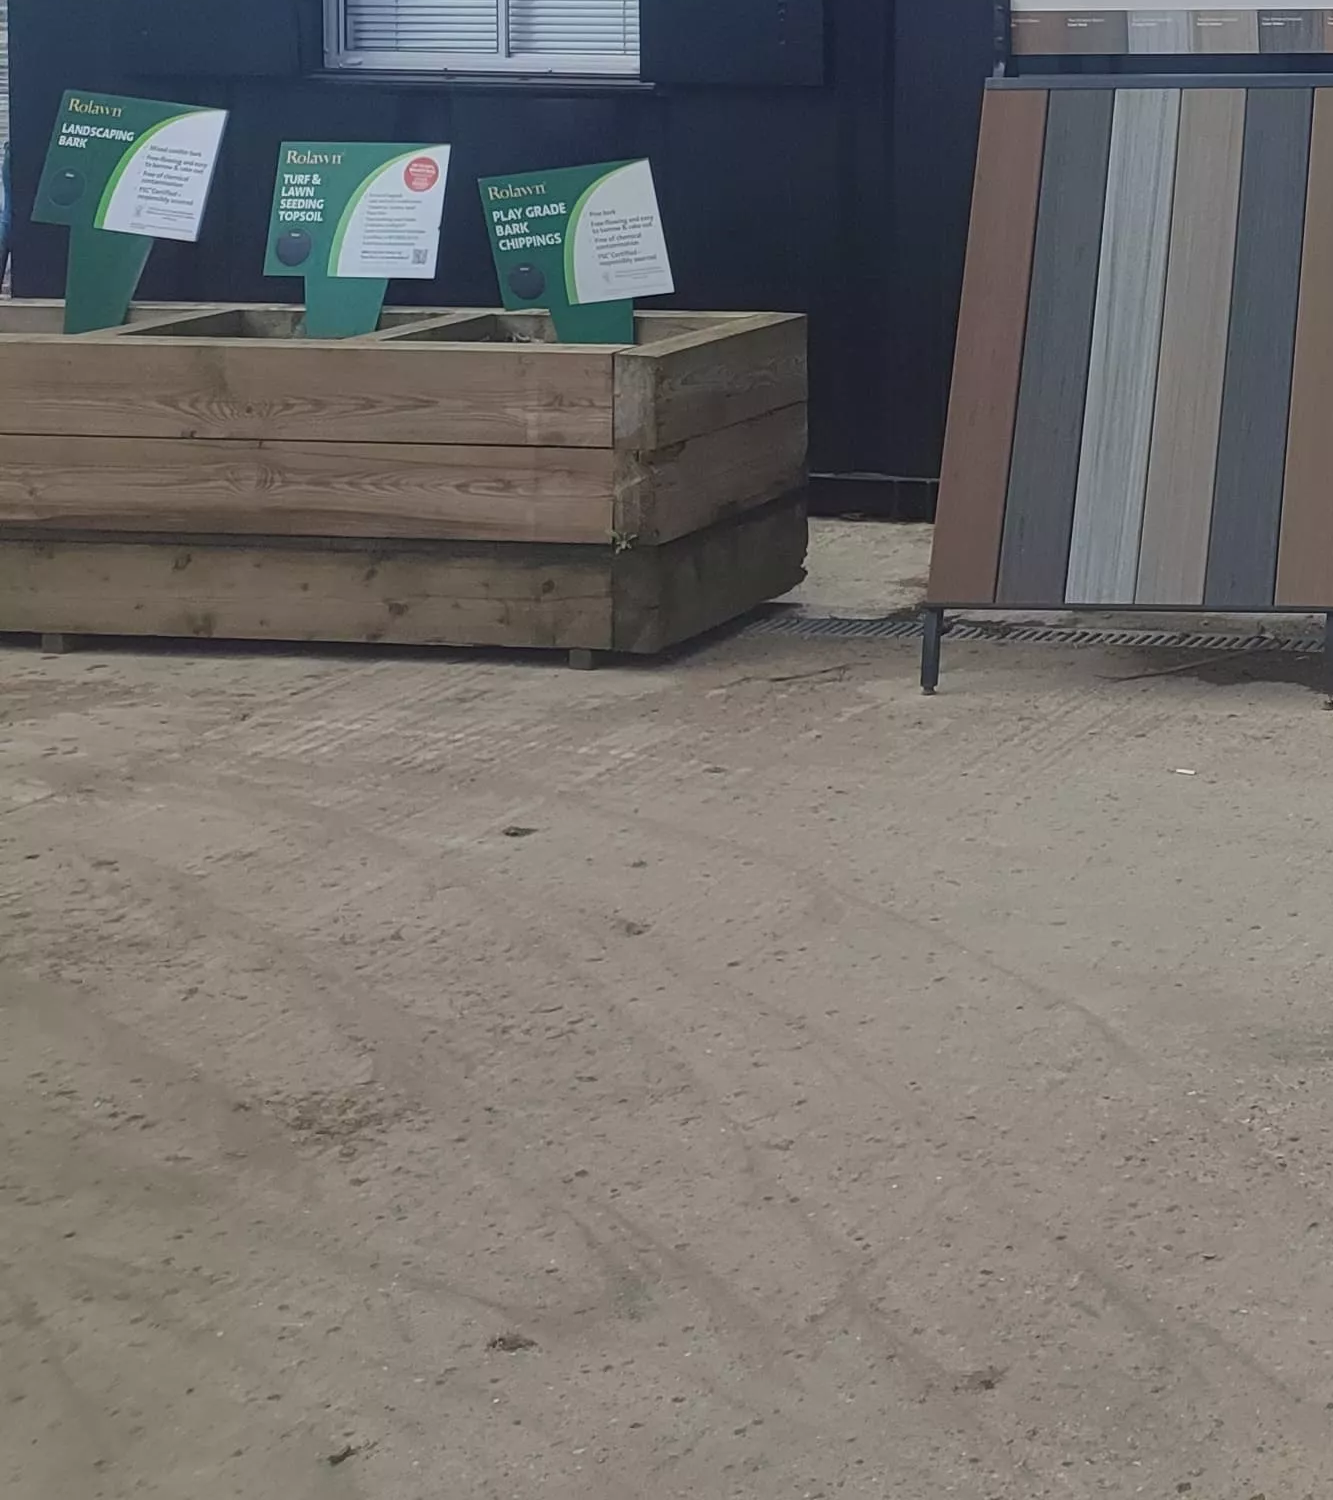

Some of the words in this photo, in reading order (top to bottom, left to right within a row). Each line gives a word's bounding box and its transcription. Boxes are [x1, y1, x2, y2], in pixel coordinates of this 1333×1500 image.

[68, 98, 122, 118] Rolawn
[61, 123, 135, 142] LANDSCAPING
[58, 136, 89, 149] BARK
[286, 150, 342, 165] Rolawn
[283, 174, 311, 185] TURF
[311, 174, 321, 185] &
[281, 186, 314, 197] LAWN
[488, 182, 546, 201] Rolawn
[280, 199, 325, 210] SEEDING
[278, 211, 324, 222] TOPSOIL
[492, 207, 523, 223] PLAY
[526, 202, 567, 218] GRADE
[495, 222, 530, 237] BARK
[498, 232, 562, 251] CHIPPINGS
